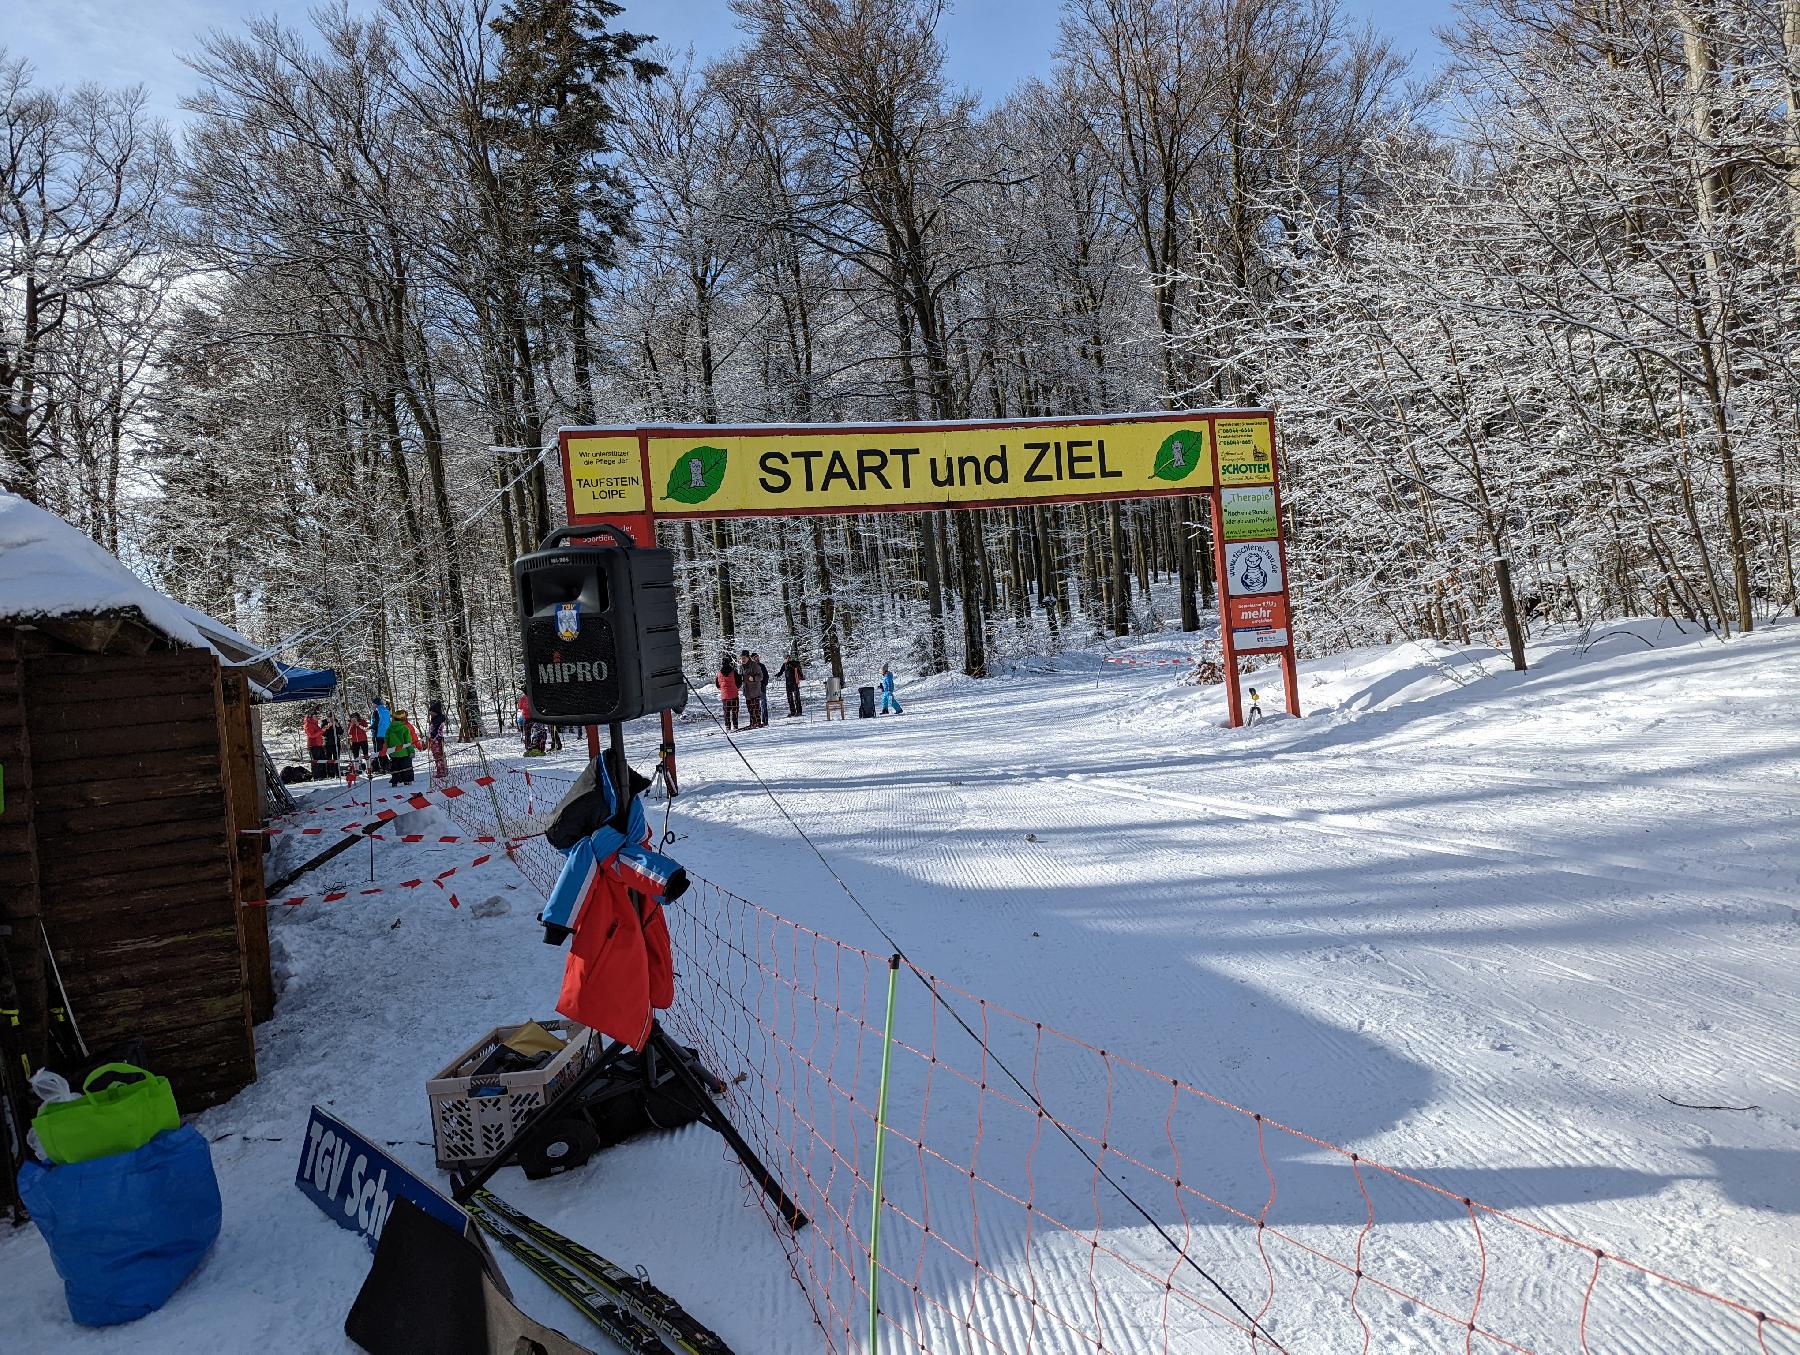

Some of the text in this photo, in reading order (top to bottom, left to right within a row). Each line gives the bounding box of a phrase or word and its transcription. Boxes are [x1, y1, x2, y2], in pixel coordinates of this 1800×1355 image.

[595, 458, 616, 466] Pflege
[758, 439, 1123, 494] START und ZIEL
[1221, 463, 1271, 475] SCHOTTEN
[575, 476, 640, 489] TAUFSTEIN
[592, 489, 627, 501] LOIPE
[1231, 490, 1270, 503] Therapie
[1240, 607, 1272, 620] mehr
[303, 1120, 351, 1202] TGV
